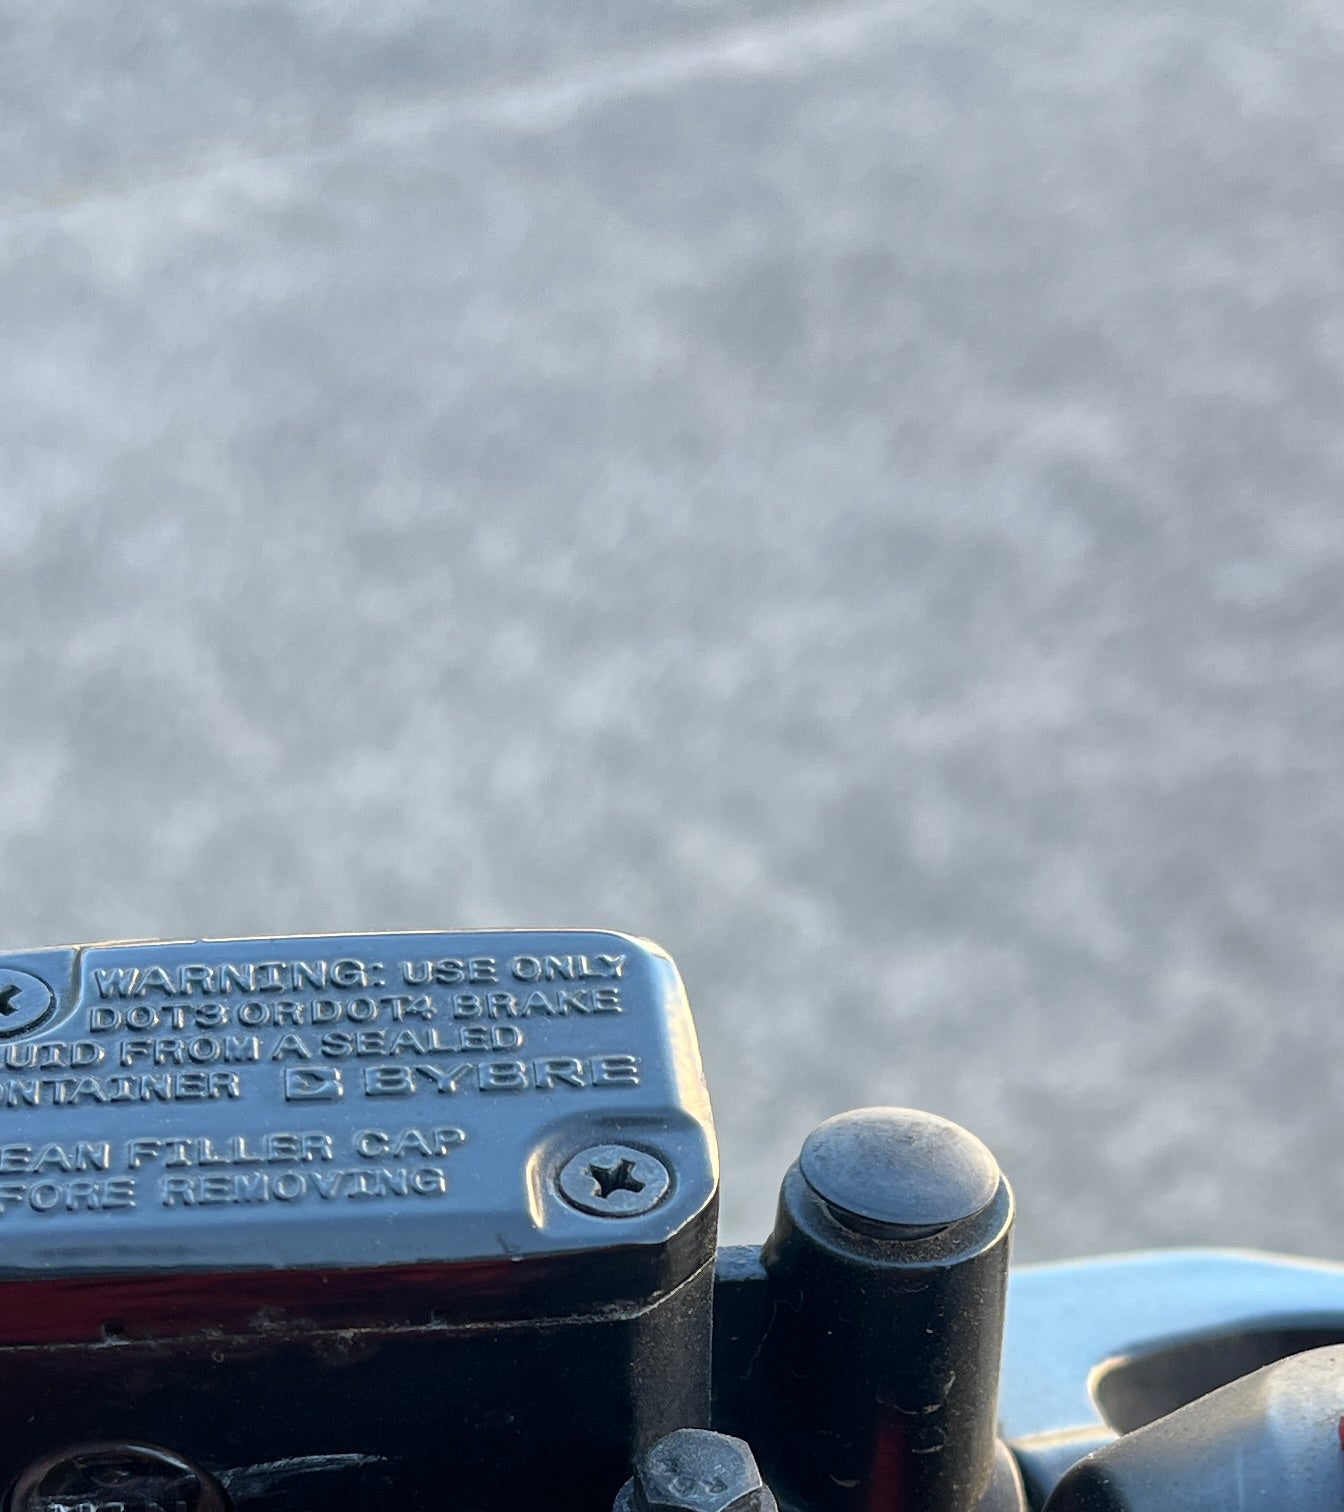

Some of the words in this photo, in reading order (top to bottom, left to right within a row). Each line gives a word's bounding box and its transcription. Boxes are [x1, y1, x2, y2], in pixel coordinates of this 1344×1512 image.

[93, 958, 386, 998] WARNING:
[402, 957, 500, 987] USE
[511, 953, 627, 982] ONLY
[452, 987, 623, 1020] BRAKE
[119, 1035, 263, 1067] FROM
[272, 1032, 313, 1061] A
[320, 1024, 524, 1057] SEALED
[363, 1055, 642, 1097] BYBRE
[127, 1130, 335, 1169] FILLER
[354, 1126, 466, 1160] CAP
[160, 1165, 447, 1206] REMOVING
